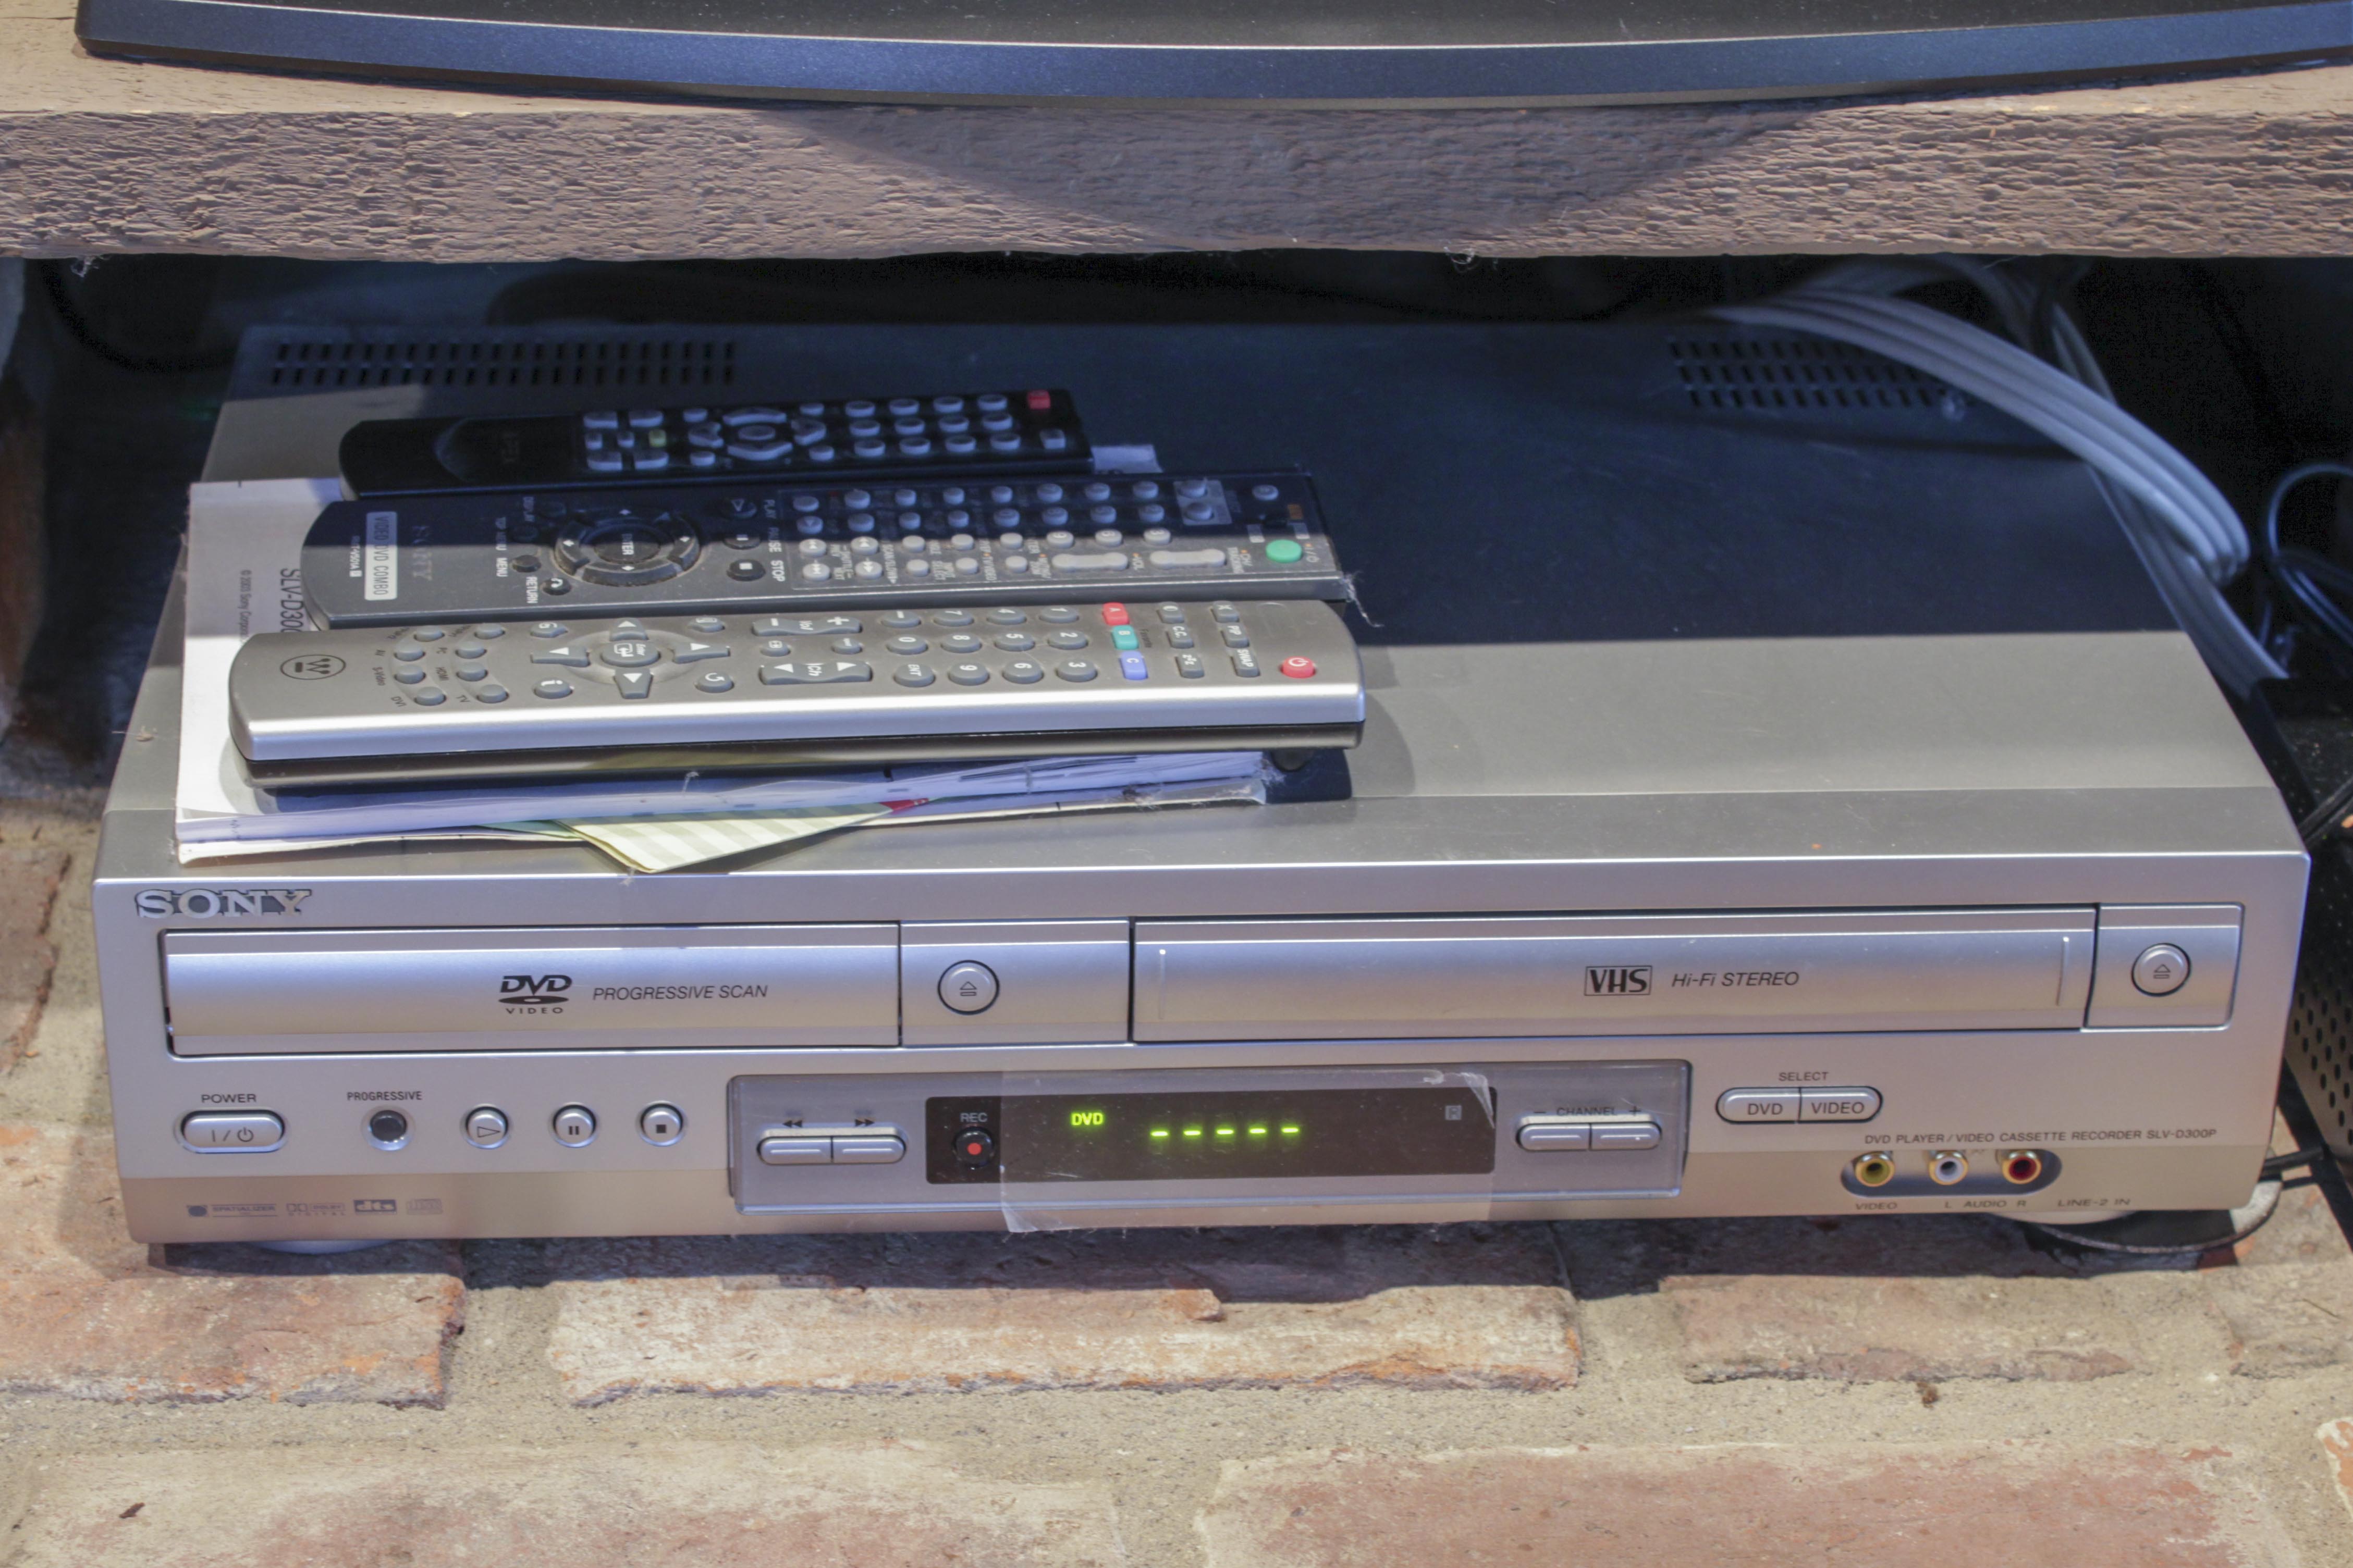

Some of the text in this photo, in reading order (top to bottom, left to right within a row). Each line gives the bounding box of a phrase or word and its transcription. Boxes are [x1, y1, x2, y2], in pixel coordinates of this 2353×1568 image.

[373, 516, 390, 596] VIDEO DVD COMBO
[496, 558, 508, 577] MENU
[770, 560, 786, 582] STOP
[525, 576, 538, 603] RETURN
[238, 593, 252, 609] Sony
[1230, 625, 1242, 636] PIP
[635, 644, 647, 657] Enter
[1237, 649, 1254, 668] SWAP
[372, 667, 385, 686] S-Video
[435, 666, 449, 681] HDMI
[907, 664, 922, 677] ENT
[391, 696, 407, 707] DVI
[457, 695, 471, 703] TV
[134, 888, 312, 919] SONY
[499, 974, 573, 996] DVD
[1589, 967, 1650, 993] VHS
[1671, 970, 1800, 988] Hi-Fi STEREO
[592, 984, 769, 1001] PROGRESSIVE SCAN
[505, 1006, 564, 1015] VIDEO
[1778, 1071, 1829, 1082] SELECT
[201, 1093, 258, 1104] POWER
[346, 1091, 423, 1102] PROGRESSIVE
[1555, 1106, 1617, 1117] CHANNEL
[1747, 1102, 1784, 1116] DVD
[1810, 1101, 1865, 1115] VIDEO
[960, 1112, 988, 1123] REC
[1071, 1112, 1105, 1126] DVD
[1865, 1133, 1892, 1144] DVD
[1999, 1131, 2067, 1142] CASSETTE
[2070, 1129, 2142, 1141] RECORDER
[2146, 1128, 2217, 1140] SLV-D300P
[212, 1205, 276, 1213] SPATIALIZER
[354, 1200, 397, 1214] dts
[1855, 1202, 1898, 1211] VIDEO
[1963, 1200, 2007, 1208] AUDIO
[2016, 1199, 2027, 1208] R
[2057, 1197, 2131, 1207] LINE-2 IN
